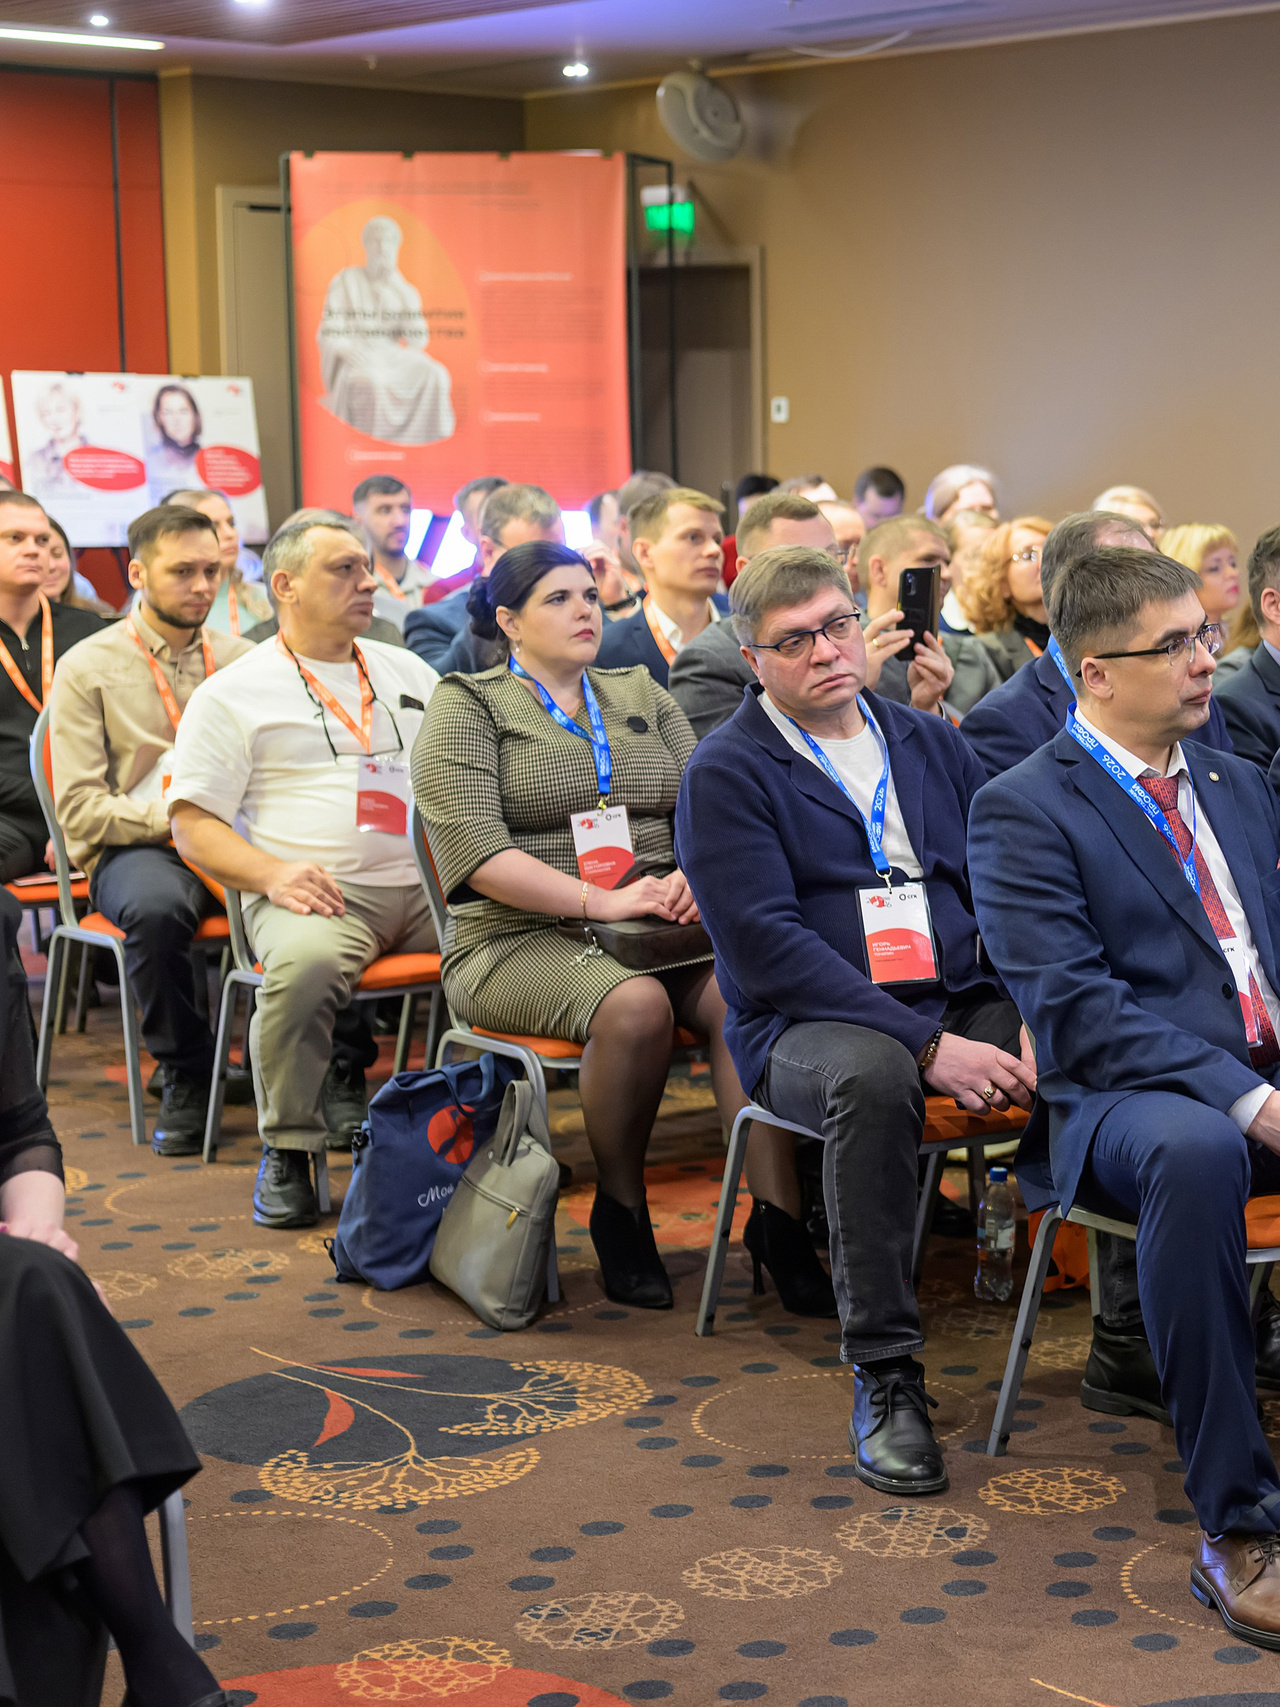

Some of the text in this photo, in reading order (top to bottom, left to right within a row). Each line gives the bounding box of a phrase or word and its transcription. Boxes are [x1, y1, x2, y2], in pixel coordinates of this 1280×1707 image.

[1070, 727, 1094, 751] НАСТАВНИК
[1072, 722, 1099, 748] ПРОФИ
[1101, 754, 1127, 780] 2026
[874, 787, 885, 812] 2026
[1128, 786, 1156, 818] НАСТАВНИК
[1131, 783, 1160, 815] ПРОФИ
[1222, 946, 1235, 954] СГК
